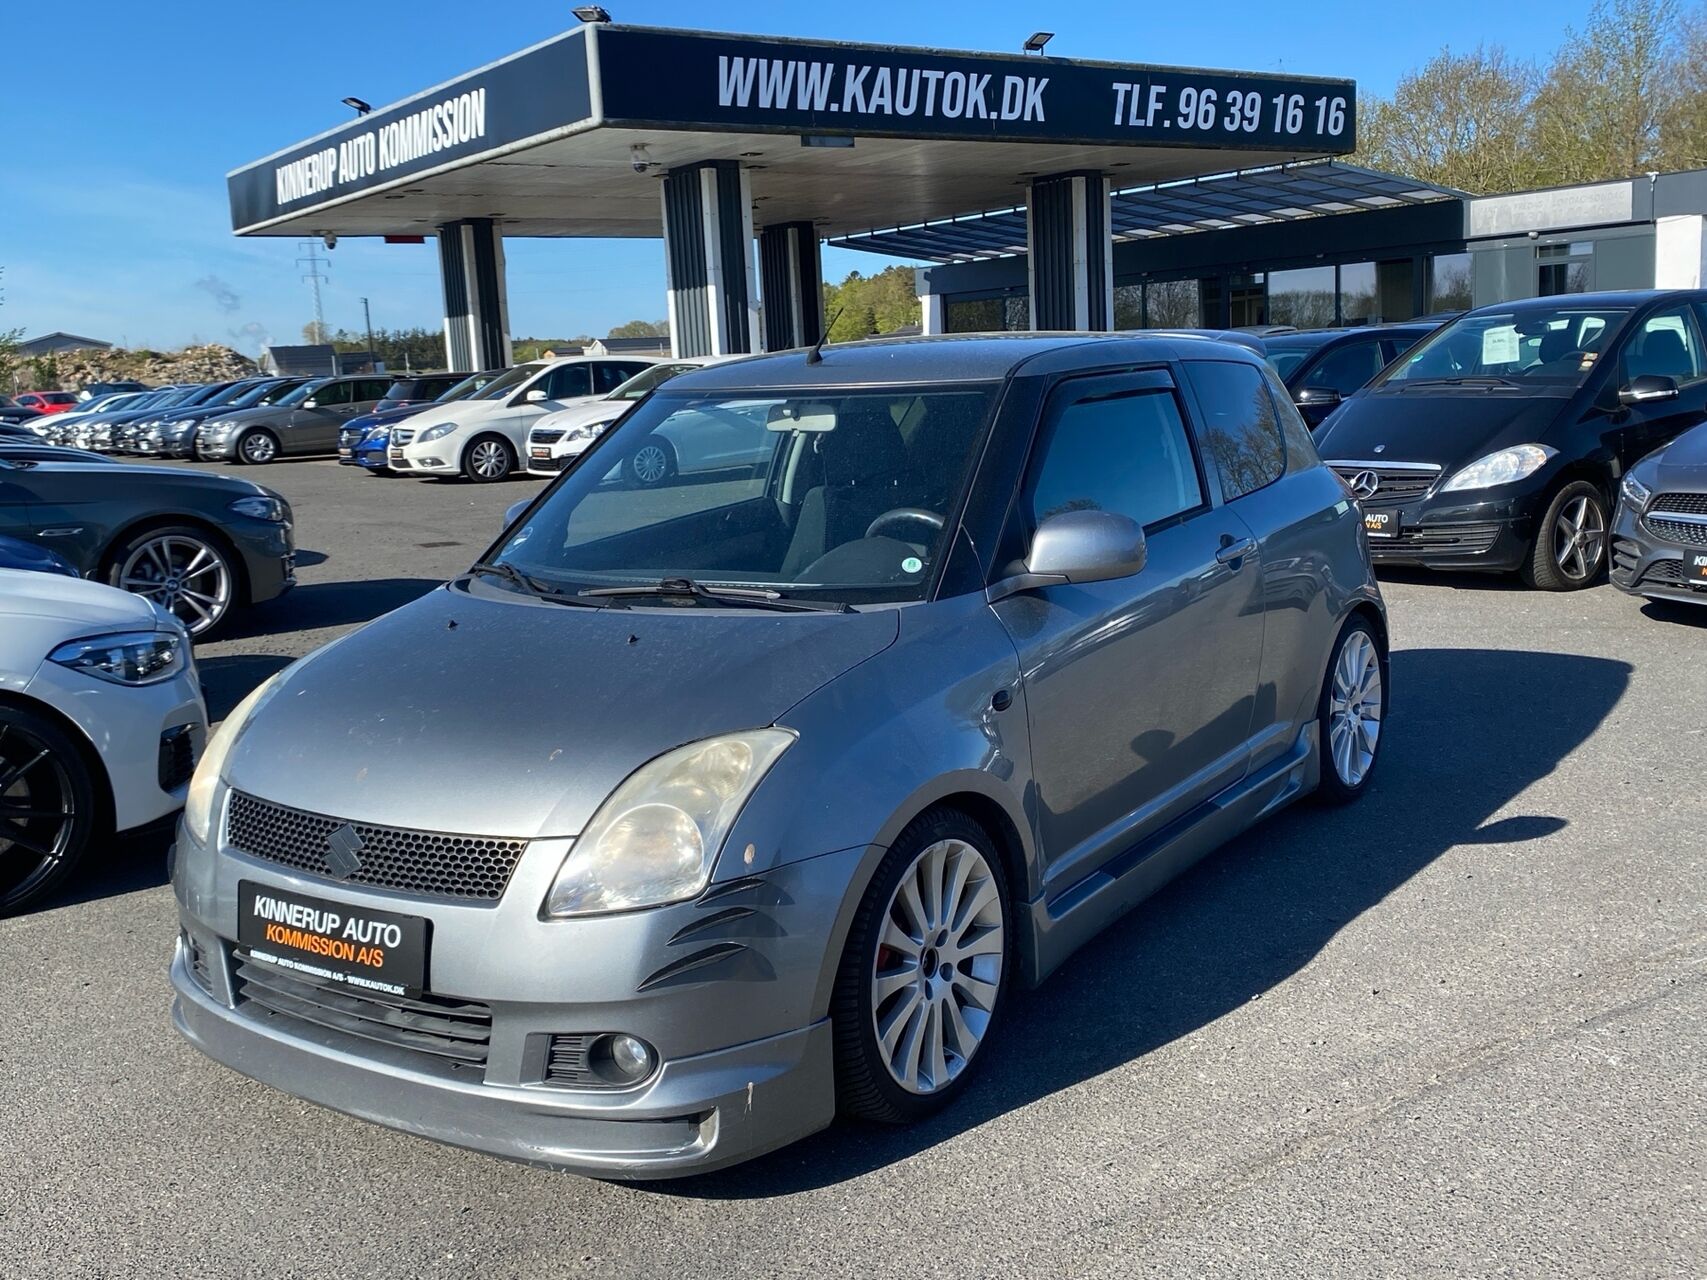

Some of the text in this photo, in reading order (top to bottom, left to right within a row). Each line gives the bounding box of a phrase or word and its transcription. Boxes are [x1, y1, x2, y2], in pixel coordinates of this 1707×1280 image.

[718, 55, 1050, 122] WWW.KAUTOK.DK
[1112, 82, 1347, 136] TLF. 96 39 16 16
[276, 87, 485, 205] KINNERUP AUTO KOMMISSION
[1365, 513, 1389, 524] AUTO
[253, 894, 402, 949] KINNERUP AUTO
[266, 923, 384, 968] KOMMISSION A/S
[277, 957, 294, 969] AUTO
